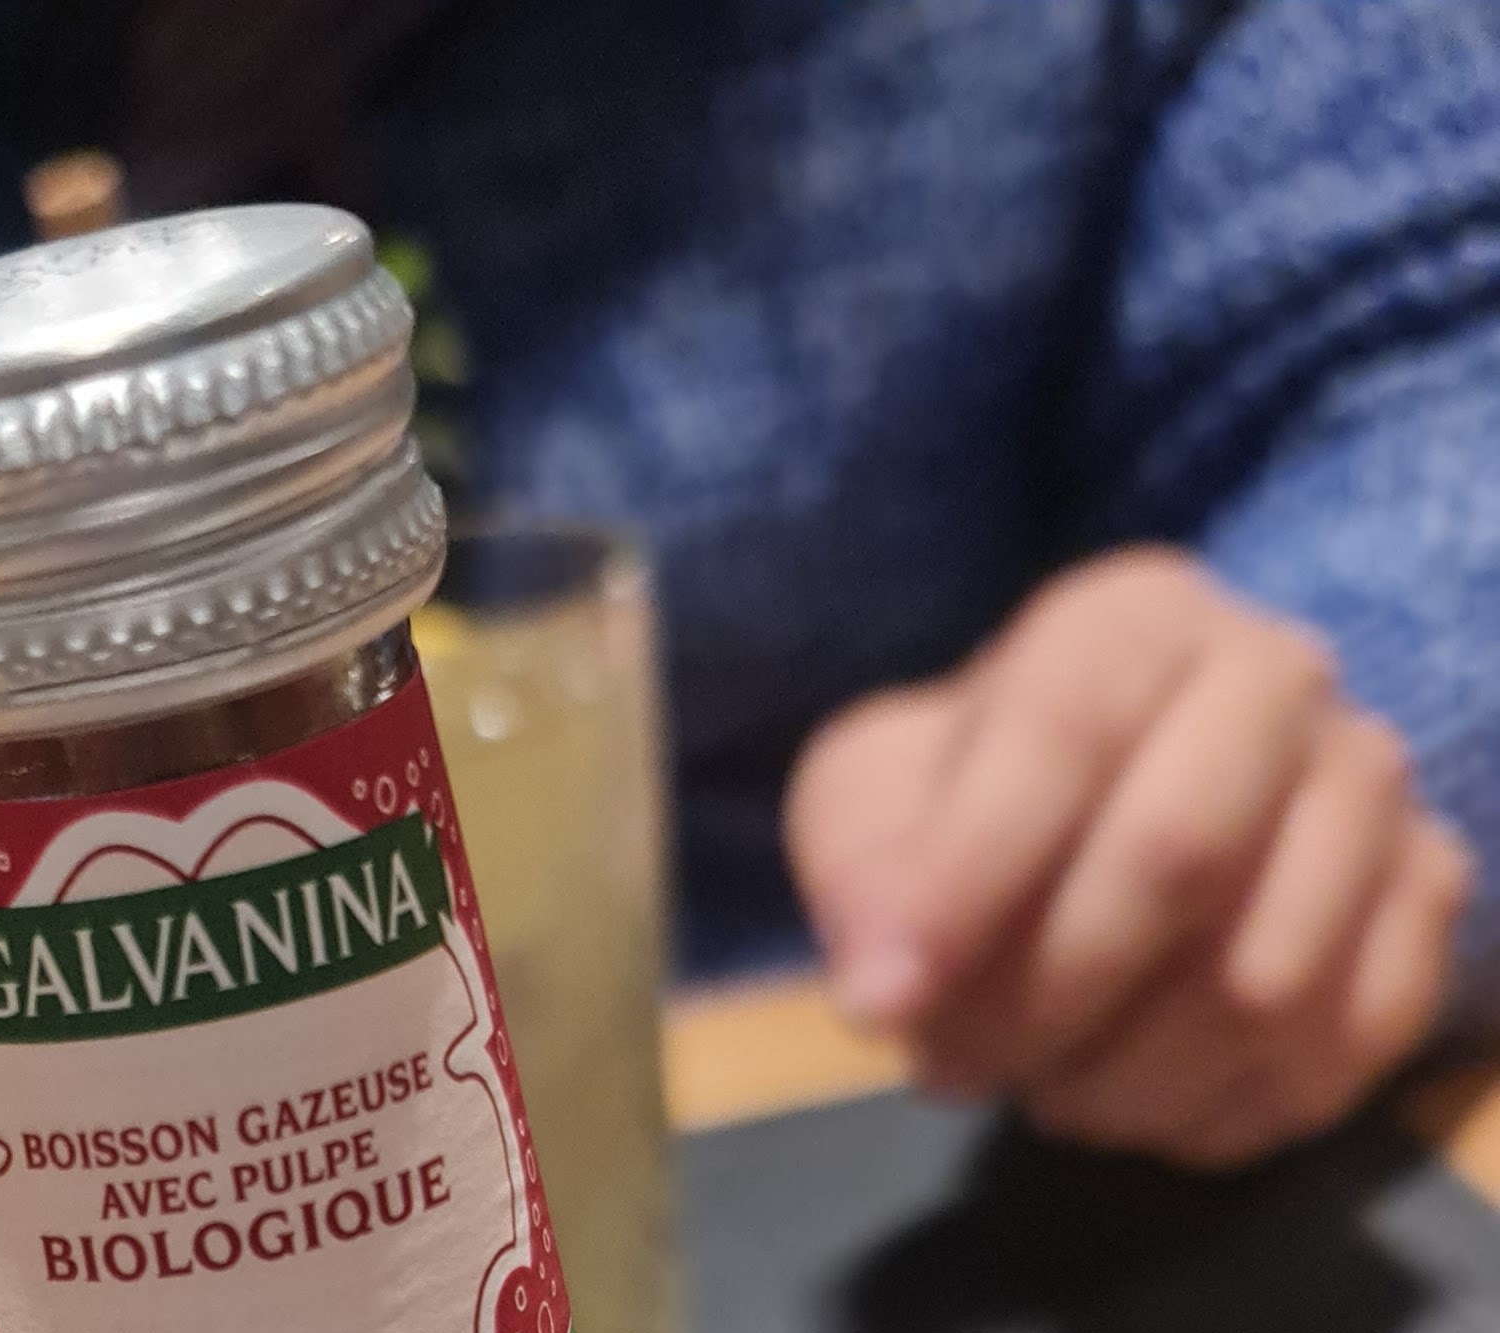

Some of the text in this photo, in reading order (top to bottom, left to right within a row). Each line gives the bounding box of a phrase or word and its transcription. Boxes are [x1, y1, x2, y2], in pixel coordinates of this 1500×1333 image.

[21, 1051, 434, 1171] BOISSON GAZEUSE
[40, 1155, 451, 1283] BIOLOGIQUE
[100, 1129, 381, 1220] AVEC PULPE
